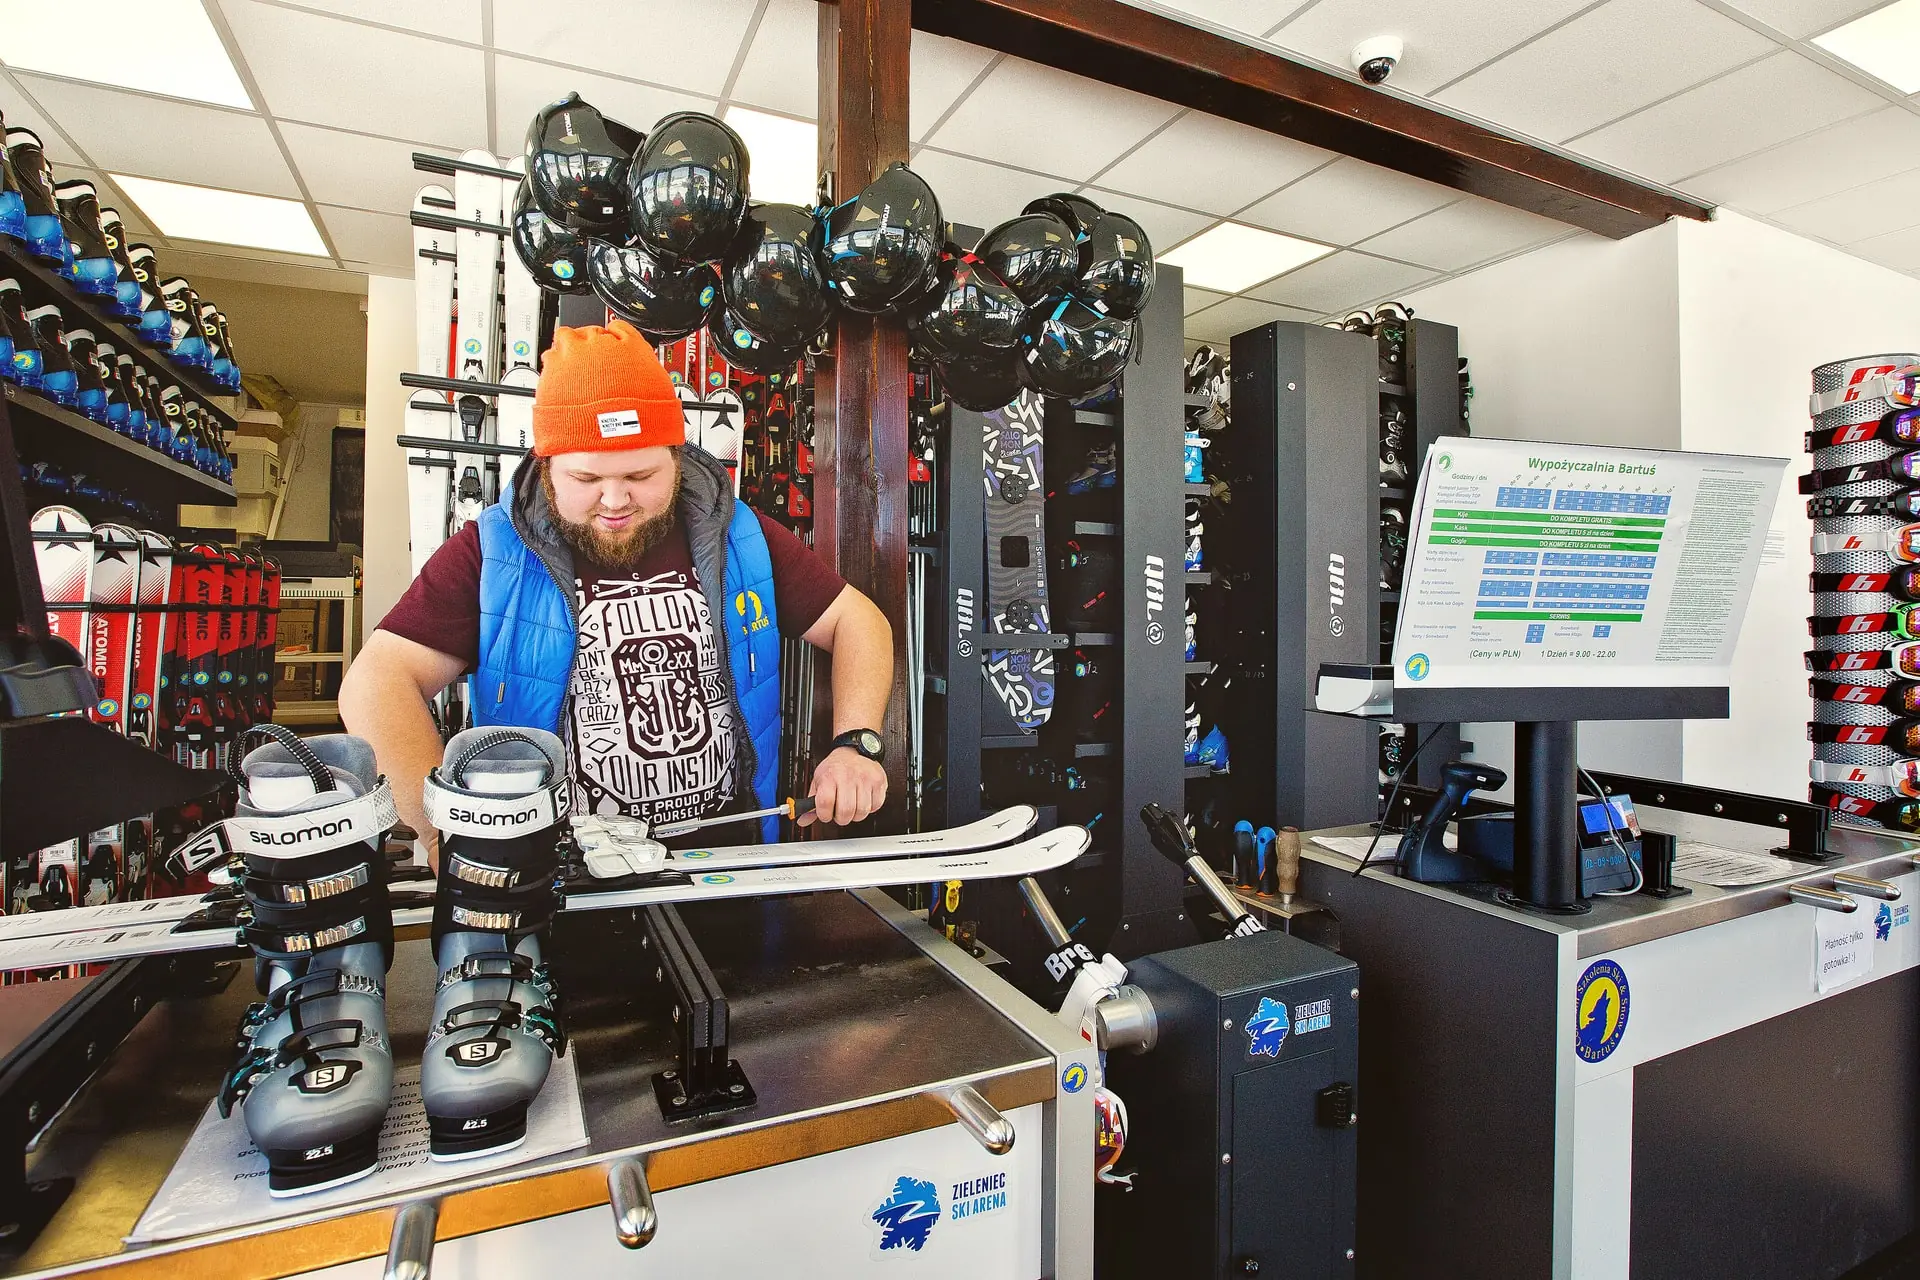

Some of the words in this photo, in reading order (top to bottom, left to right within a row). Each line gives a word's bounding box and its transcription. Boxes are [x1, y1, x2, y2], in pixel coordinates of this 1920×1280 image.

[1451, 473, 1475, 481] Godziny
[1528, 457, 1615, 474] Wypożyczalnia
[1618, 463, 1657, 476] Bartuś
[1144, 554, 1164, 621] QBL
[602, 592, 701, 648] FOLLOW
[95, 617, 109, 676] ATOMIC
[1469, 650, 1492, 659] (Ceny
[1502, 650, 1521, 659] PLN)
[1546, 650, 1567, 658] Dzień
[1575, 650, 1591, 658] 9.00
[574, 678, 612, 695] LAZY
[579, 704, 619, 723] CRAZY
[592, 754, 661, 800] YOUR
[655, 791, 701, 814] PROUD
[643, 804, 706, 827] YOURSELF
[1578, 966, 1611, 994] Szkolenia
[1611, 967, 1623, 984] Ski
[1295, 998, 1331, 1020] ZIELENIEC
[1295, 1018, 1308, 1036] SKI
[1308, 1013, 1331, 1032] ARENA
[1584, 1037, 1616, 1060] Bartuś
[952, 1171, 1006, 1203] ZIELENIEC
[951, 1202, 972, 1222] SKI
[973, 1193, 1007, 1219] ARENA
